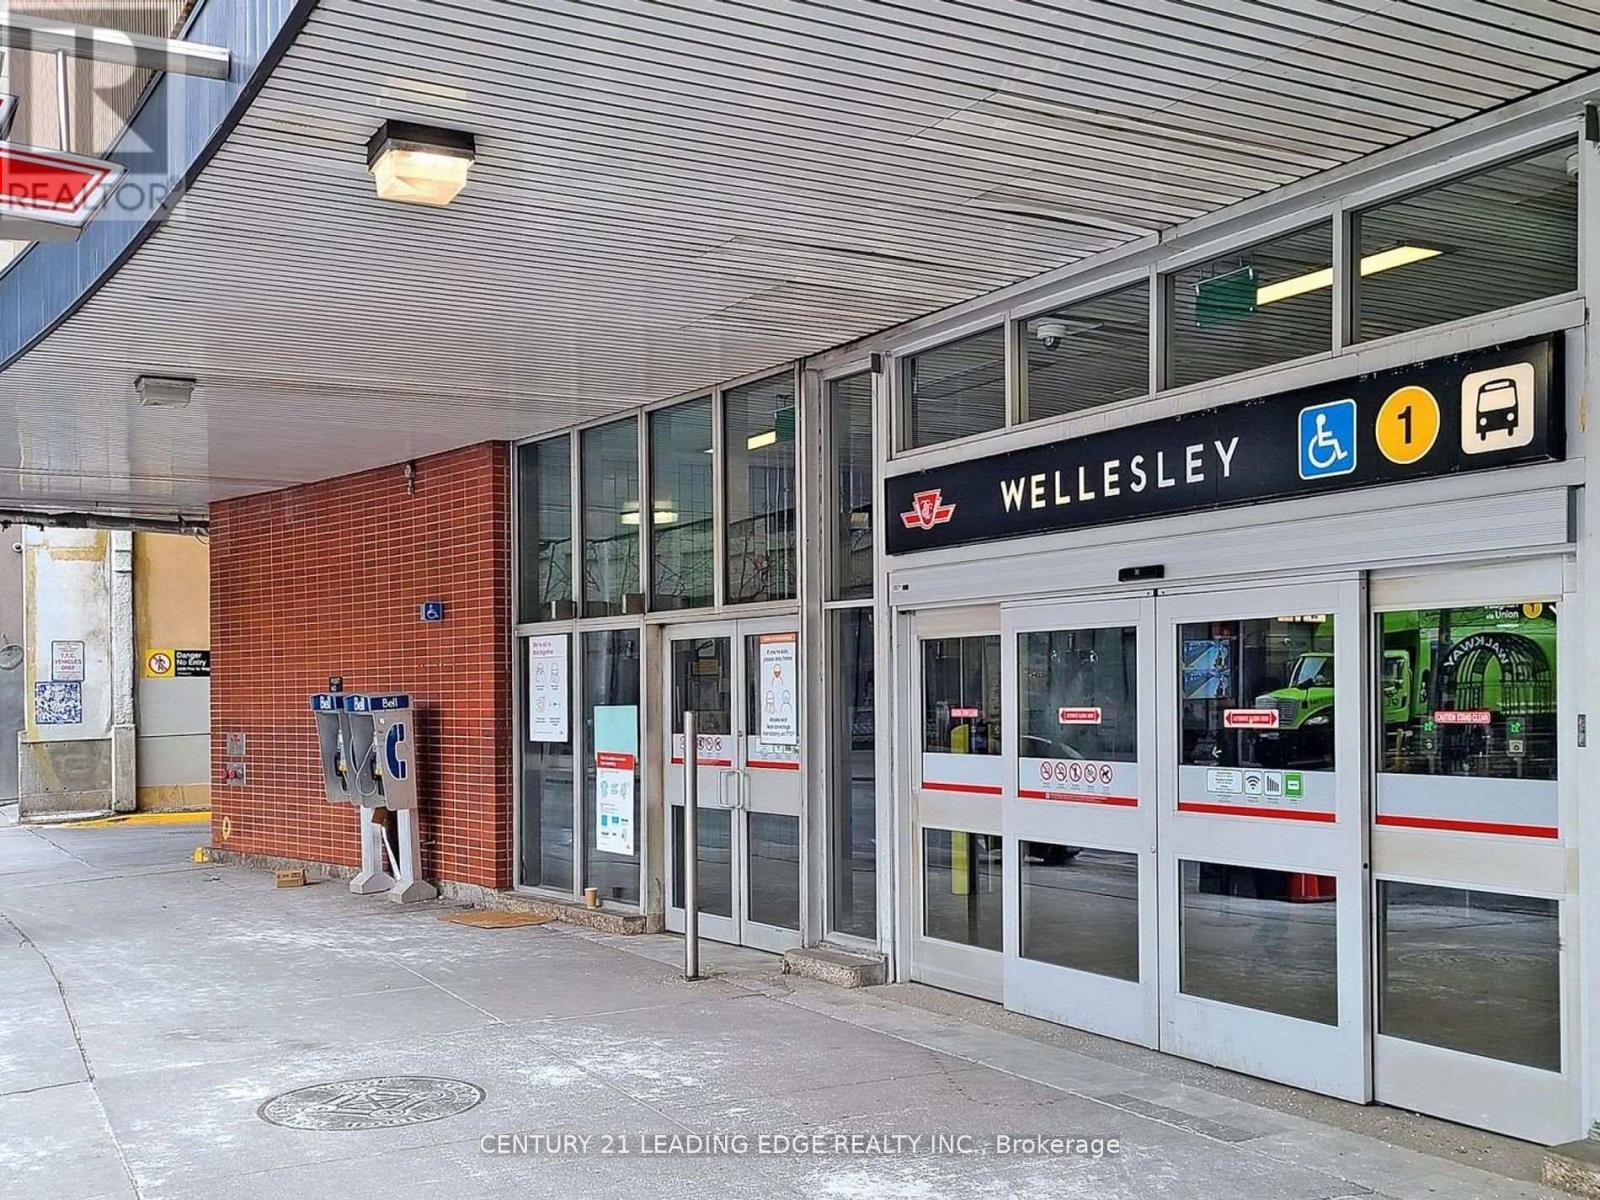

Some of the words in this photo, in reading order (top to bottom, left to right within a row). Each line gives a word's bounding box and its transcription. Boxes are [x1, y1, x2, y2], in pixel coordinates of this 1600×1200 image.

[1397, 405, 1412, 445] 1
[1000, 436, 1239, 513] WELLESLEY
[1495, 610, 1519, 619] Union
[176, 652, 202, 660] Danger
[353, 696, 365, 711] Bell
[382, 697, 399, 708] Bell
